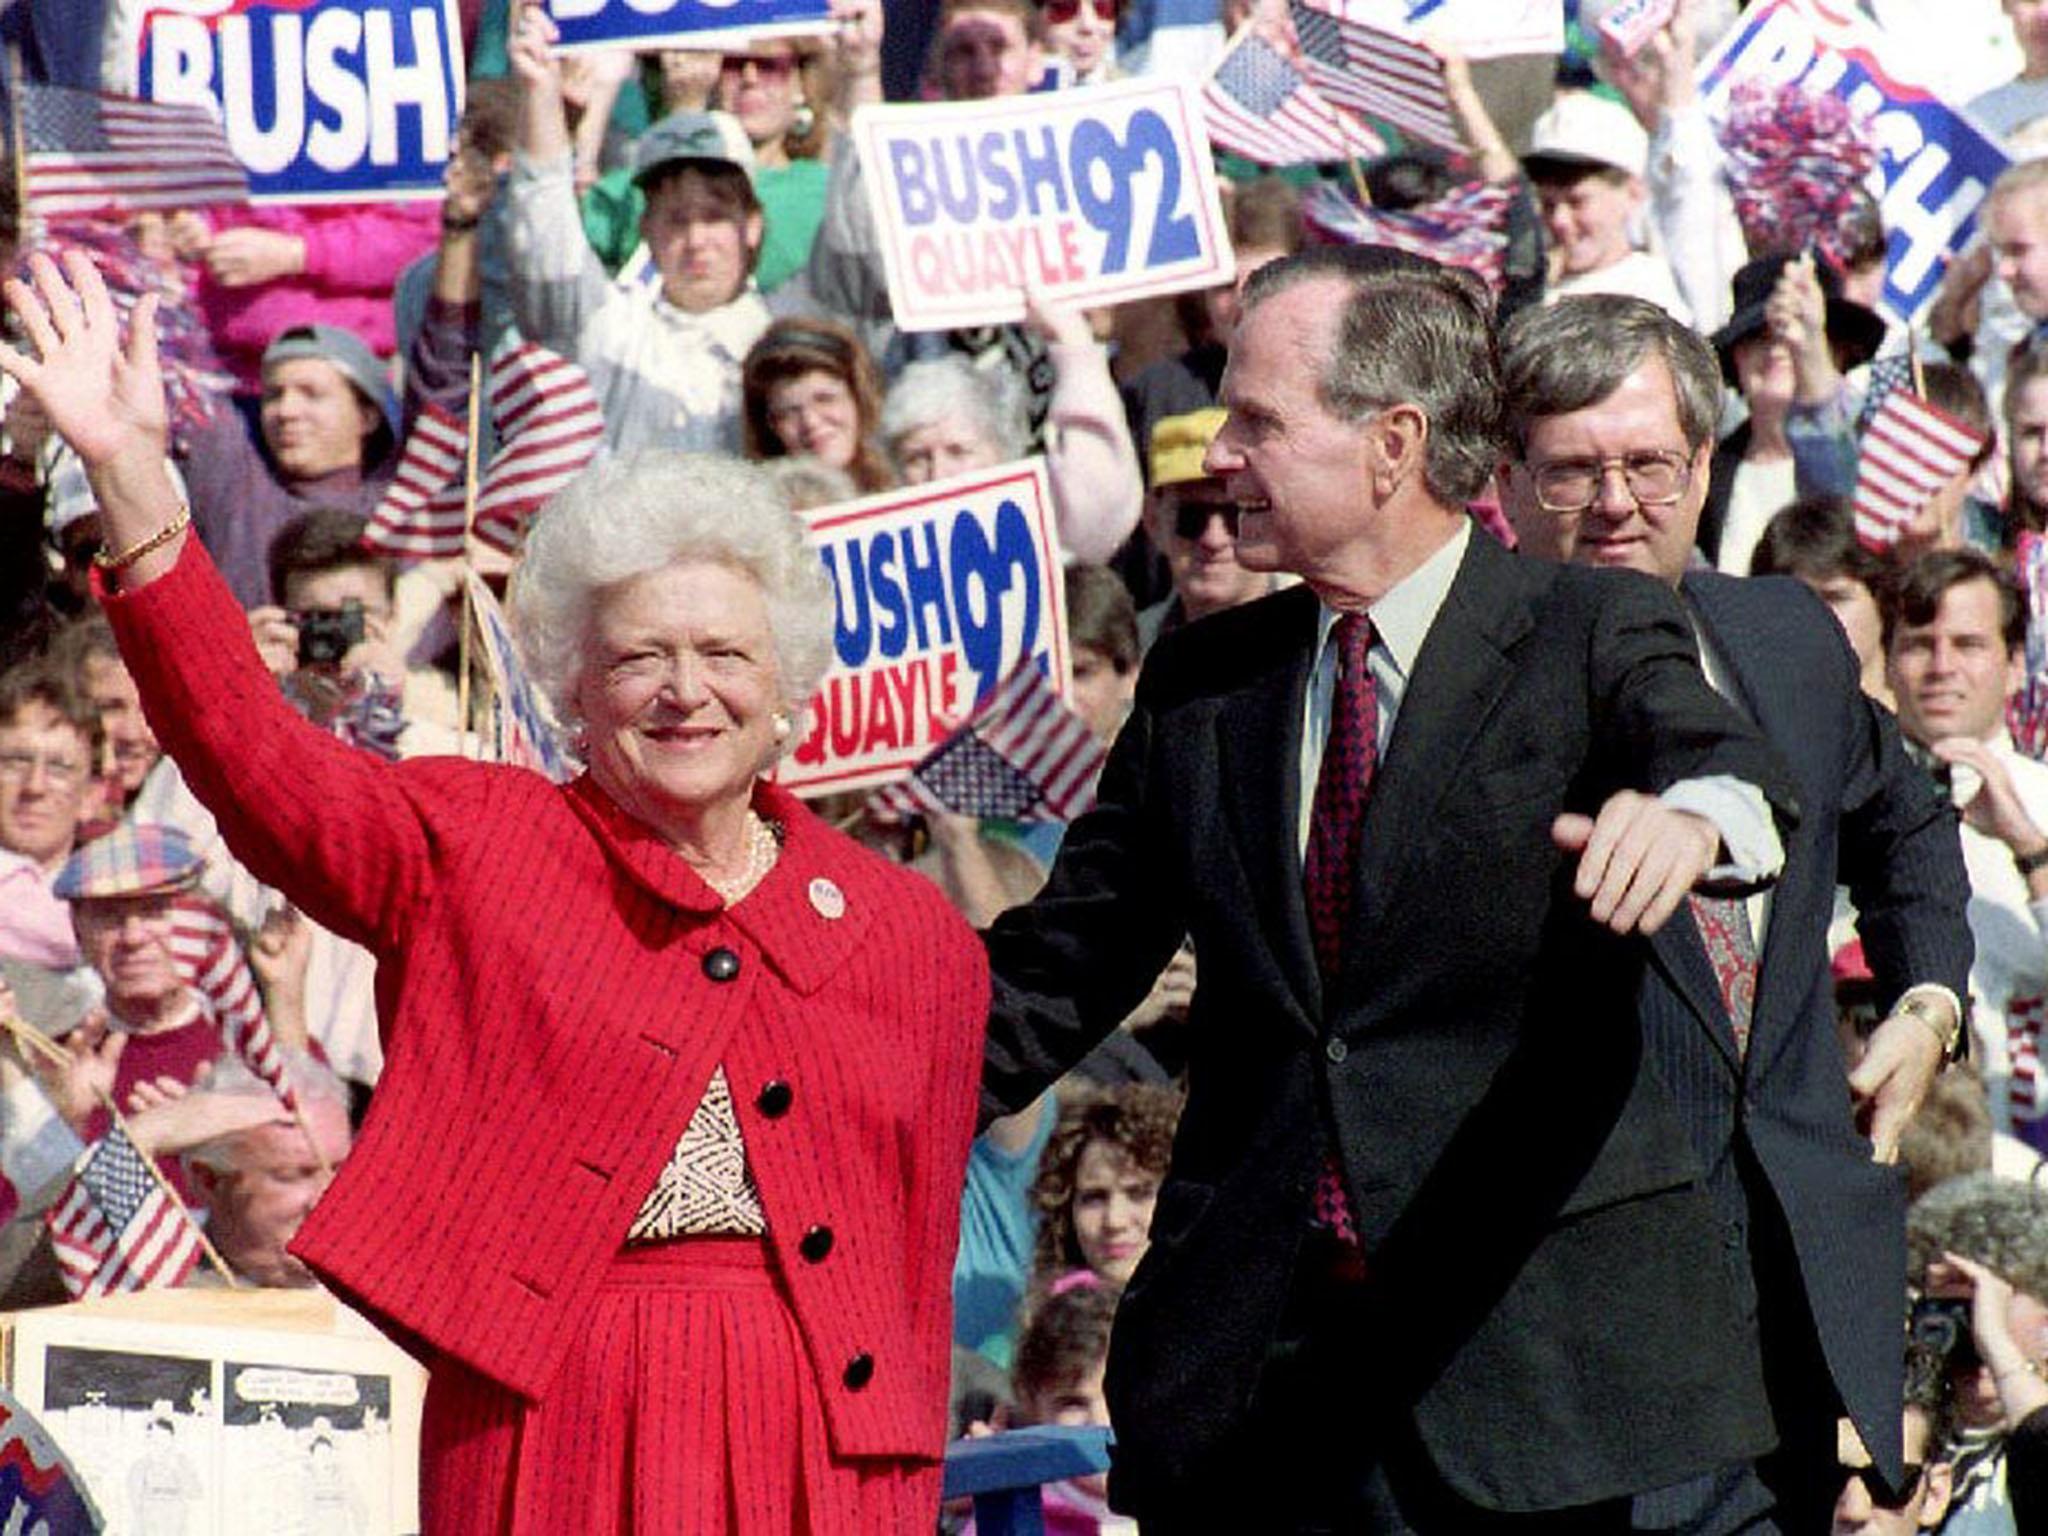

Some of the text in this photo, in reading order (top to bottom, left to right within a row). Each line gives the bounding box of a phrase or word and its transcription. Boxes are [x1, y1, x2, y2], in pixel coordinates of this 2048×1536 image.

[153, 7, 450, 173] BUSH
[888, 107, 1201, 275] BUSH 92
[911, 221, 1085, 296] QUAYLE
[820, 519, 952, 668] USH
